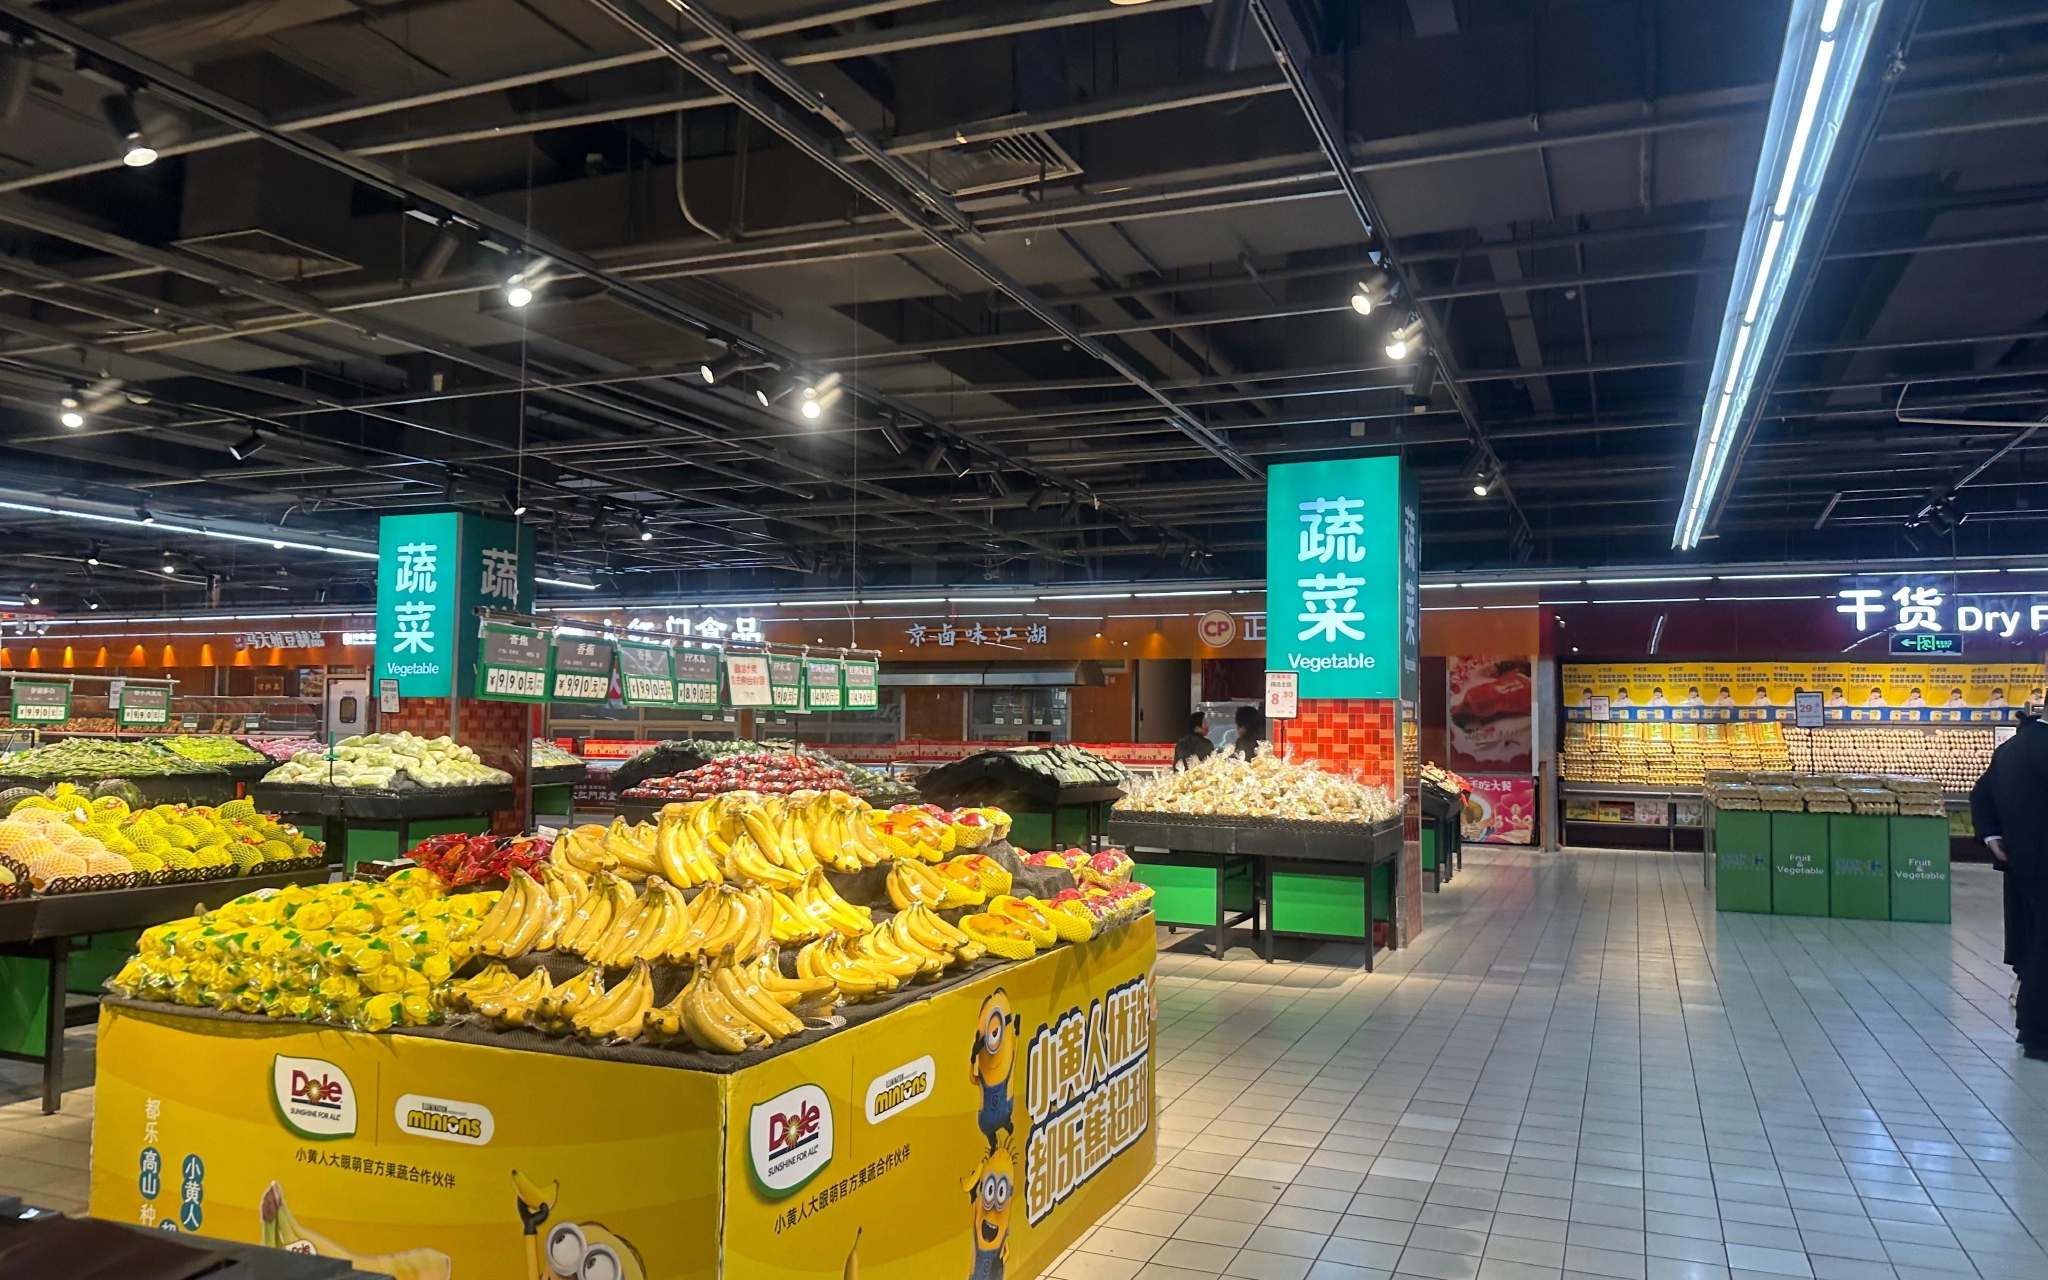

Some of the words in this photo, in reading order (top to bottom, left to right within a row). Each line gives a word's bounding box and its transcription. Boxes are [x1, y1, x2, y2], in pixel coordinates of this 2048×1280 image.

[1297, 495, 1366, 643] 蔬菜
[392, 541, 438, 654] 蔬菜
[1836, 586, 1943, 632] 干货
[1957, 606, 2021, 638] Dry
[908, 622, 1048, 648] 京卤味江湖
[1204, 620, 1230, 637] CP
[387, 662, 440, 678] Vegetable
[1287, 652, 1376, 673] Vegetable
[1776, 865, 1825, 876] Vegetable
[1789, 853, 1811, 862] Fruit
[1908, 858, 1932, 867] Fruit
[1895, 870, 1946, 881] Vegetable
[1029, 979, 1150, 1122] 小黄人优选
[292, 1069, 343, 1103] Dole
[290, 1107, 317, 1118] SUNSHINE
[317, 1111, 329, 1119] FOR
[769, 1100, 821, 1152] Dole
[295, 1146, 456, 1190] 小黄人大眼萌官方果蔬合作伙伴
[768, 1156, 797, 1177] SUNSHINE
[796, 1150, 808, 1163] FOR
[182, 1156, 202, 1229] 小黄人
[774, 1143, 911, 1235] 小黄人大眼萌官方果蔬合作伙伴
